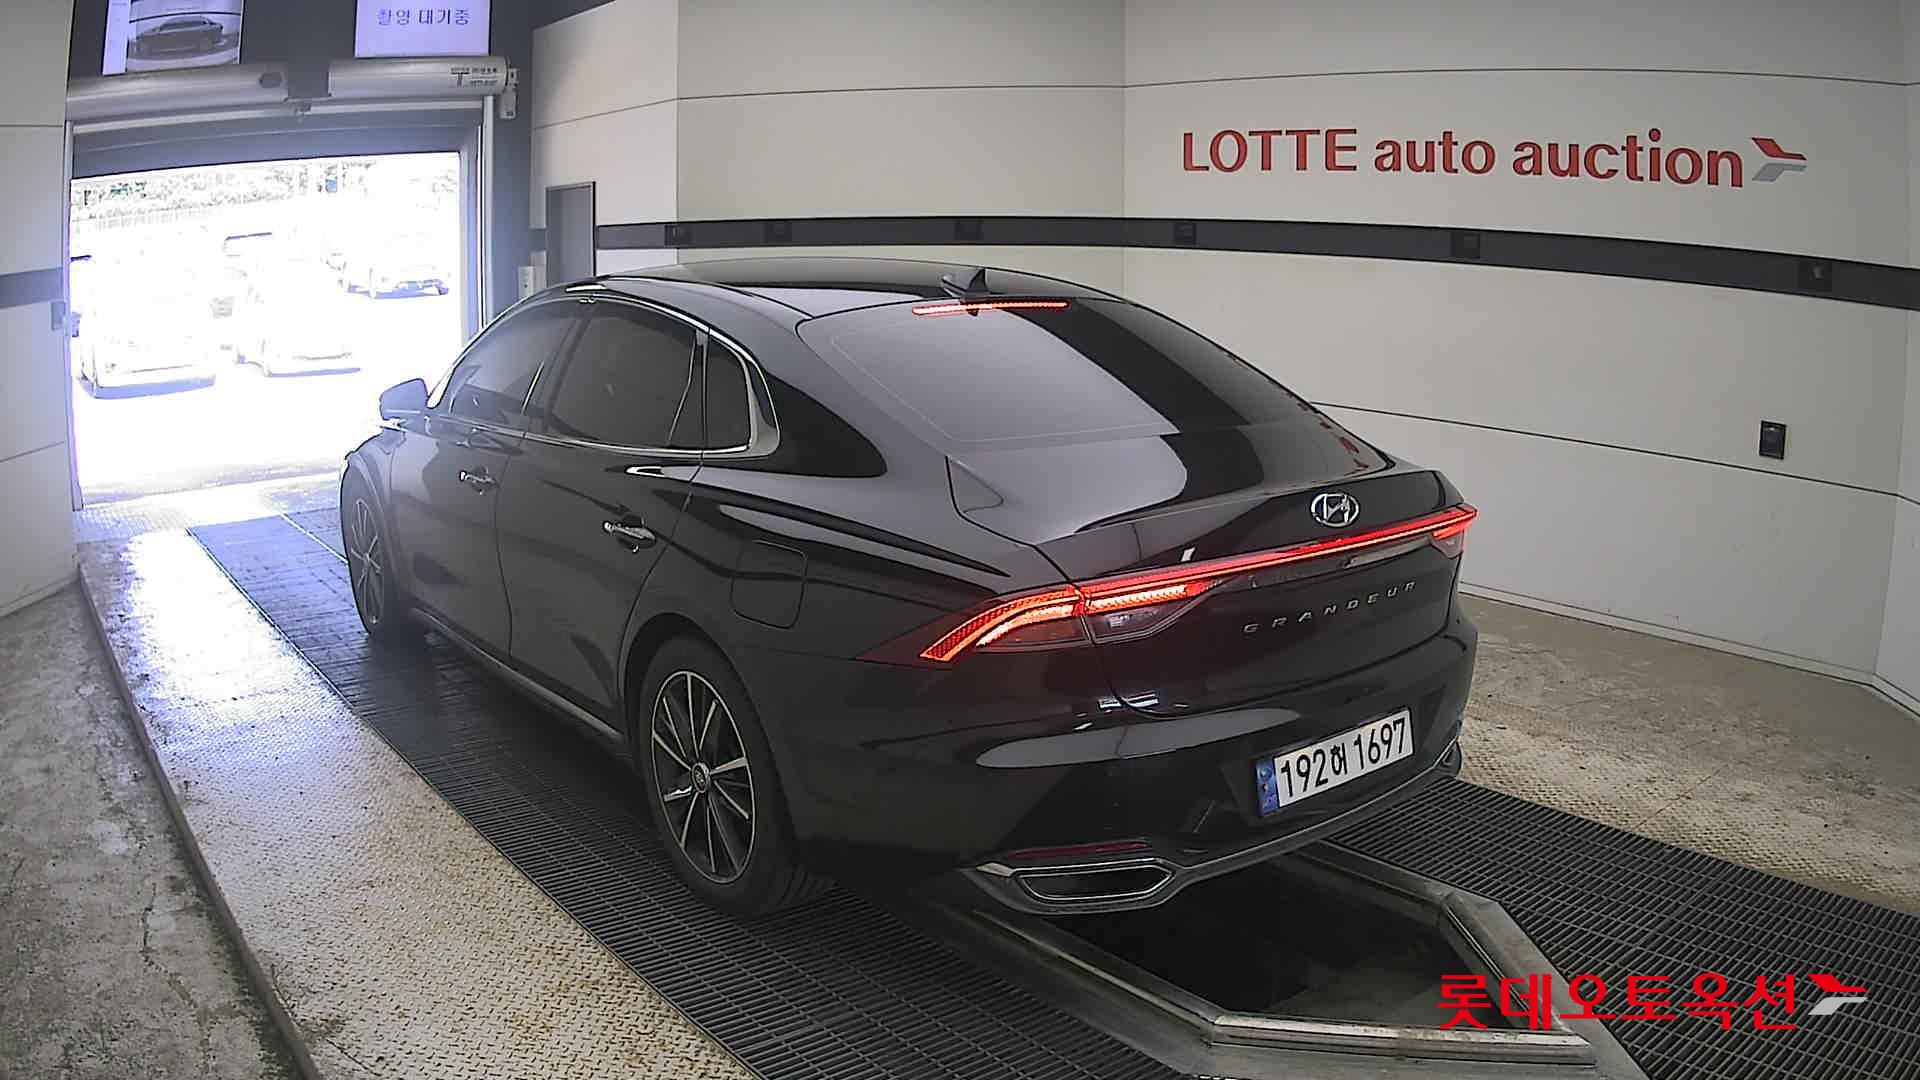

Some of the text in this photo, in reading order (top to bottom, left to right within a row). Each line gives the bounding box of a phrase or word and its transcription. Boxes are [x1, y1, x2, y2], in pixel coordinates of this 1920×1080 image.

[418, 8, 469, 26] 대기중
[1183, 127, 1744, 189] LOTTE auto auction
[1243, 580, 1417, 633] GRANDEUR
[1280, 717, 1406, 798] 192허 1697
